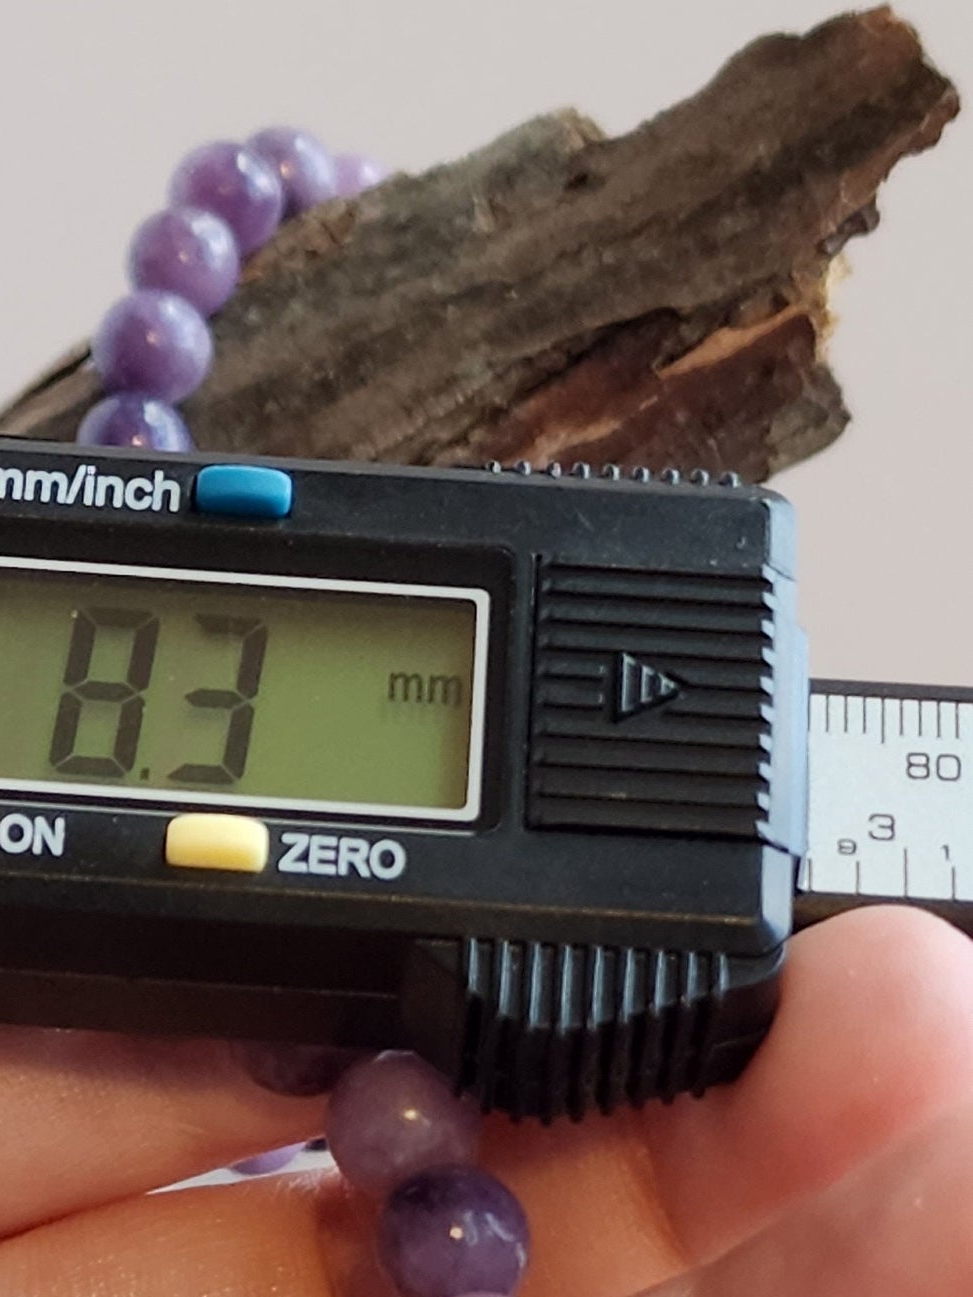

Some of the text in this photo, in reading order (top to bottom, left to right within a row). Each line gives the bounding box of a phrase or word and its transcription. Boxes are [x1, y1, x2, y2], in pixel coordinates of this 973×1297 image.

[49, 606, 464, 784] 8.3 mm
[906, 752, 961, 781] 80
[868, 813, 895, 840] 3
[277, 831, 407, 881] ZERO
